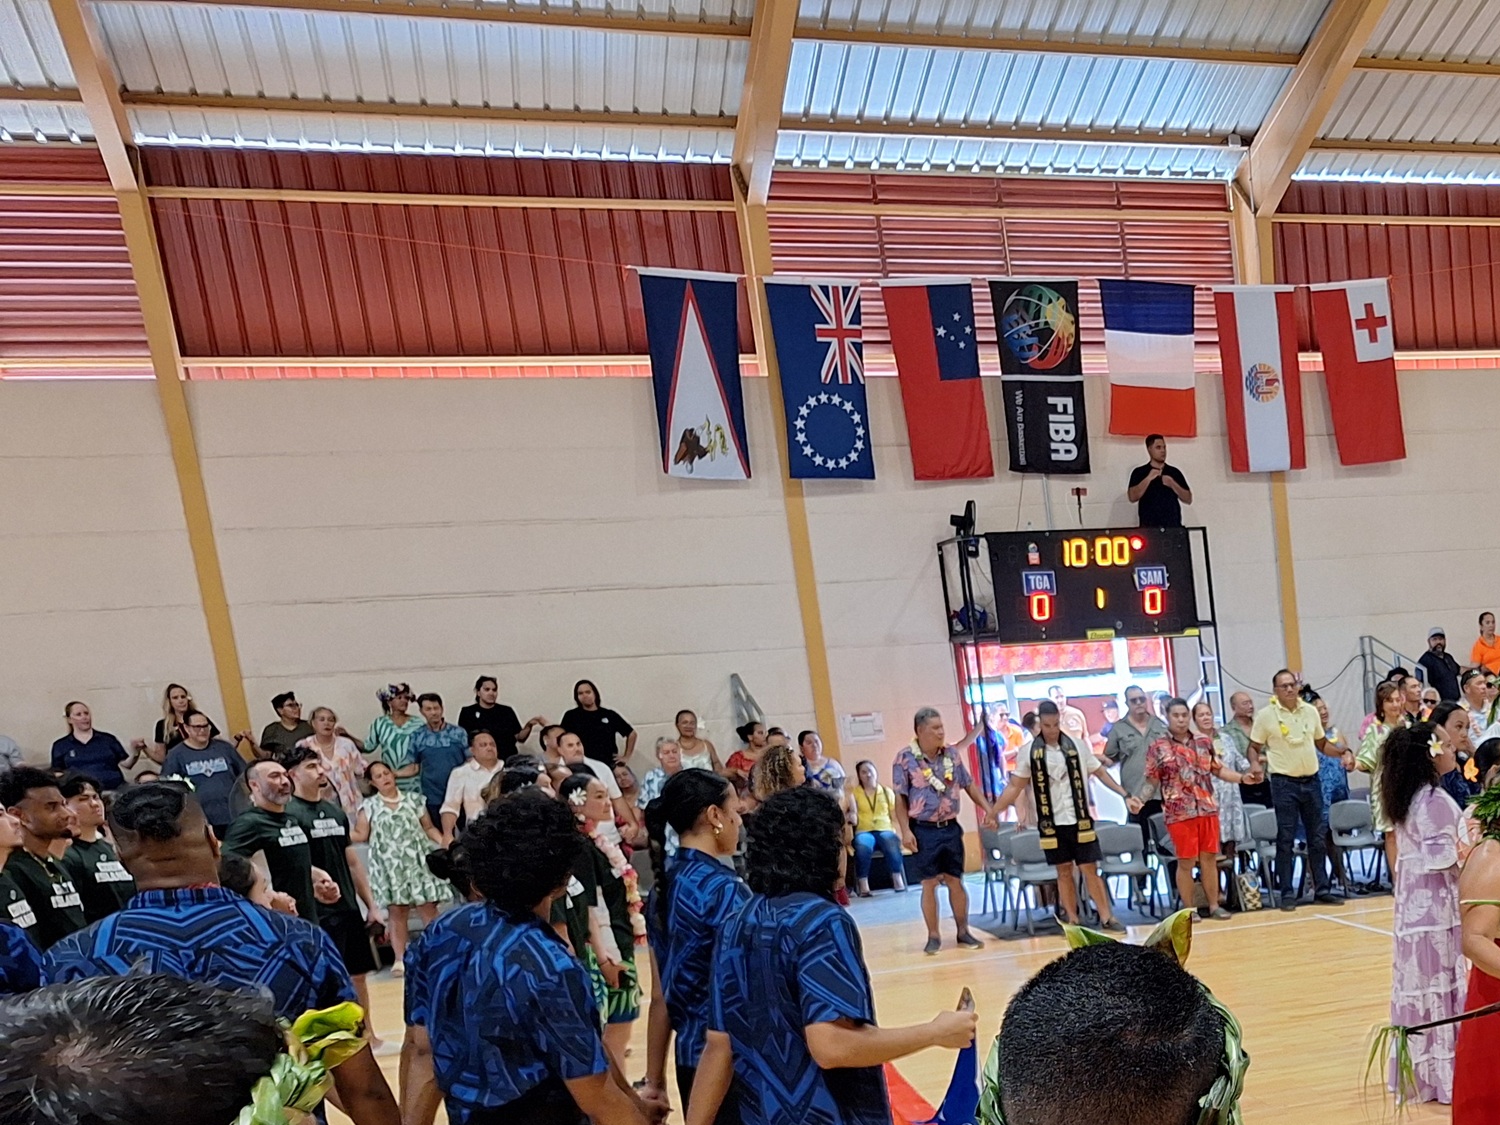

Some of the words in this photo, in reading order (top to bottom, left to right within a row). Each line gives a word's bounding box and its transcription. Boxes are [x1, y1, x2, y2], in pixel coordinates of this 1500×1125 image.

[1015, 390, 1024, 406] We
[1047, 396, 1078, 462] FIBA
[1063, 536, 1130, 567] 10:00
[1028, 576, 1050, 591] TGA
[1140, 571, 1163, 586] SAM
[1032, 594, 1050, 621] 0
[1096, 587, 1105, 609] 1
[1144, 588, 1162, 615] 0
[1033, 748, 1050, 816] MISTER
[1071, 759, 1085, 818] TAHITI
